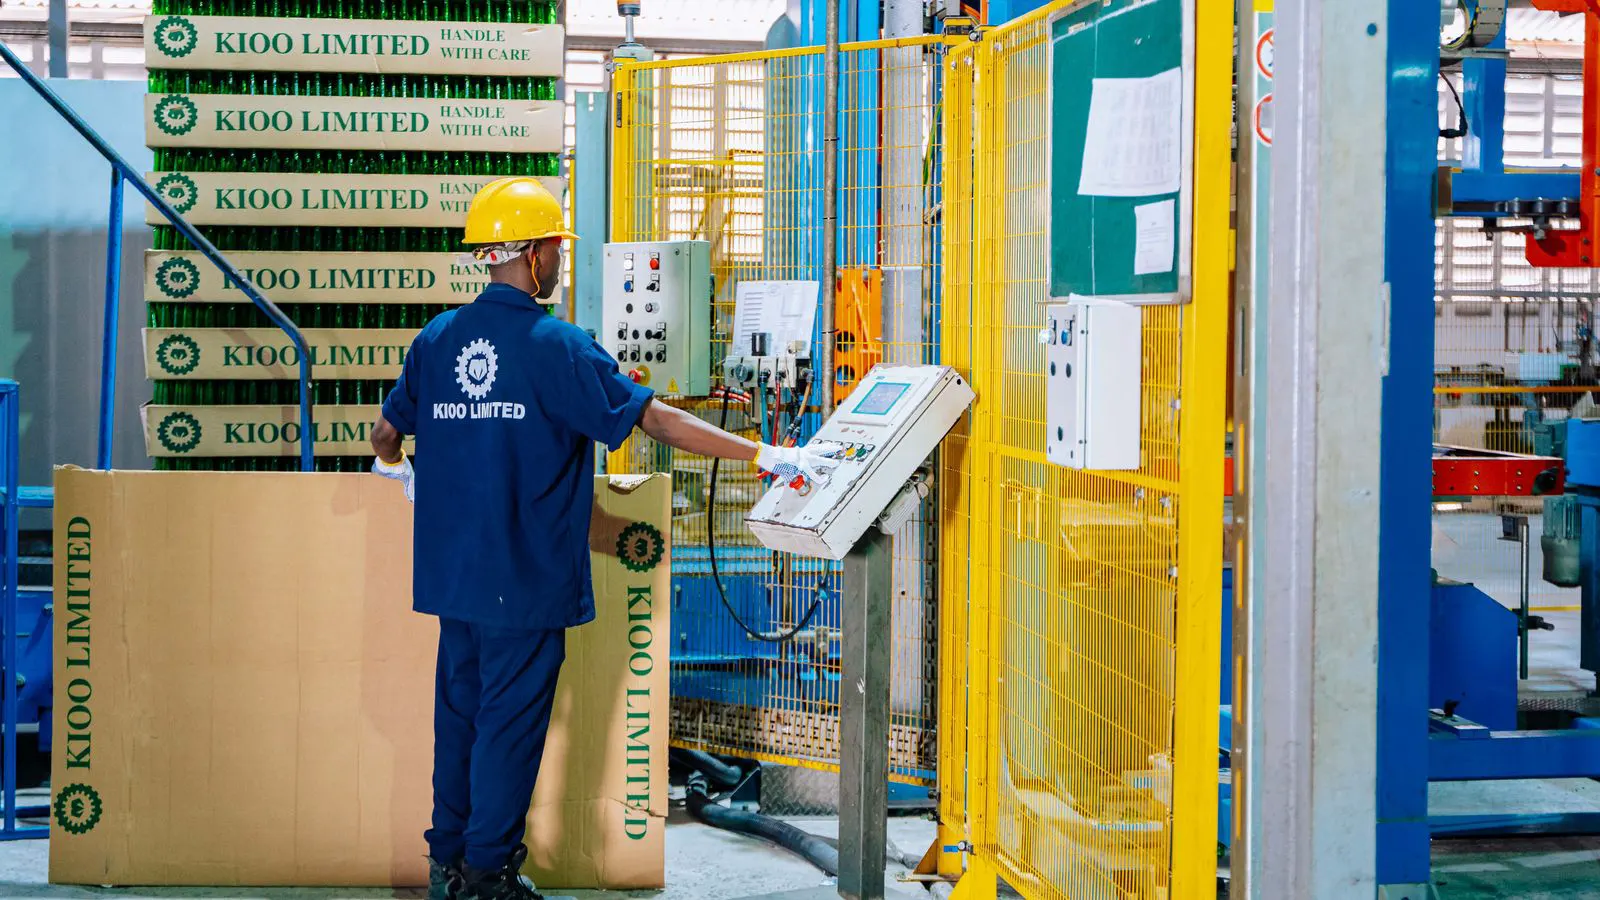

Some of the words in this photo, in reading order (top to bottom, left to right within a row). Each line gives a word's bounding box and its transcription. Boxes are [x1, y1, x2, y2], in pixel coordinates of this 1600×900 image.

[215, 32, 293, 55] KIOO
[302, 33, 430, 56] LIMITED
[440, 28, 505, 42] HANDLE
[440, 47, 483, 60] WITH
[487, 48, 530, 61] CARE
[215, 110, 293, 132] KIOO
[302, 110, 430, 133] LIMITED
[440, 105, 505, 119] HANDLE
[440, 123, 482, 137] WITH
[487, 125, 530, 137] CARE
[215, 188, 293, 210] KIOO
[301, 188, 429, 210] LIMITED
[440, 182, 484, 195] HAND
[440, 200, 472, 213] WIT
[308, 268, 436, 289] LIMITED
[450, 264, 491, 276] HAN
[223, 345, 300, 367] KIOO
[433, 402, 467, 419] KIOO
[470, 401, 526, 420] LIMITED
[223, 422, 301, 444] KIOO
[66, 516, 92, 669] LIMITED
[626, 584, 653, 676] KIOO
[66, 678, 92, 770] KIOO
[624, 688, 651, 841] LIMITED
